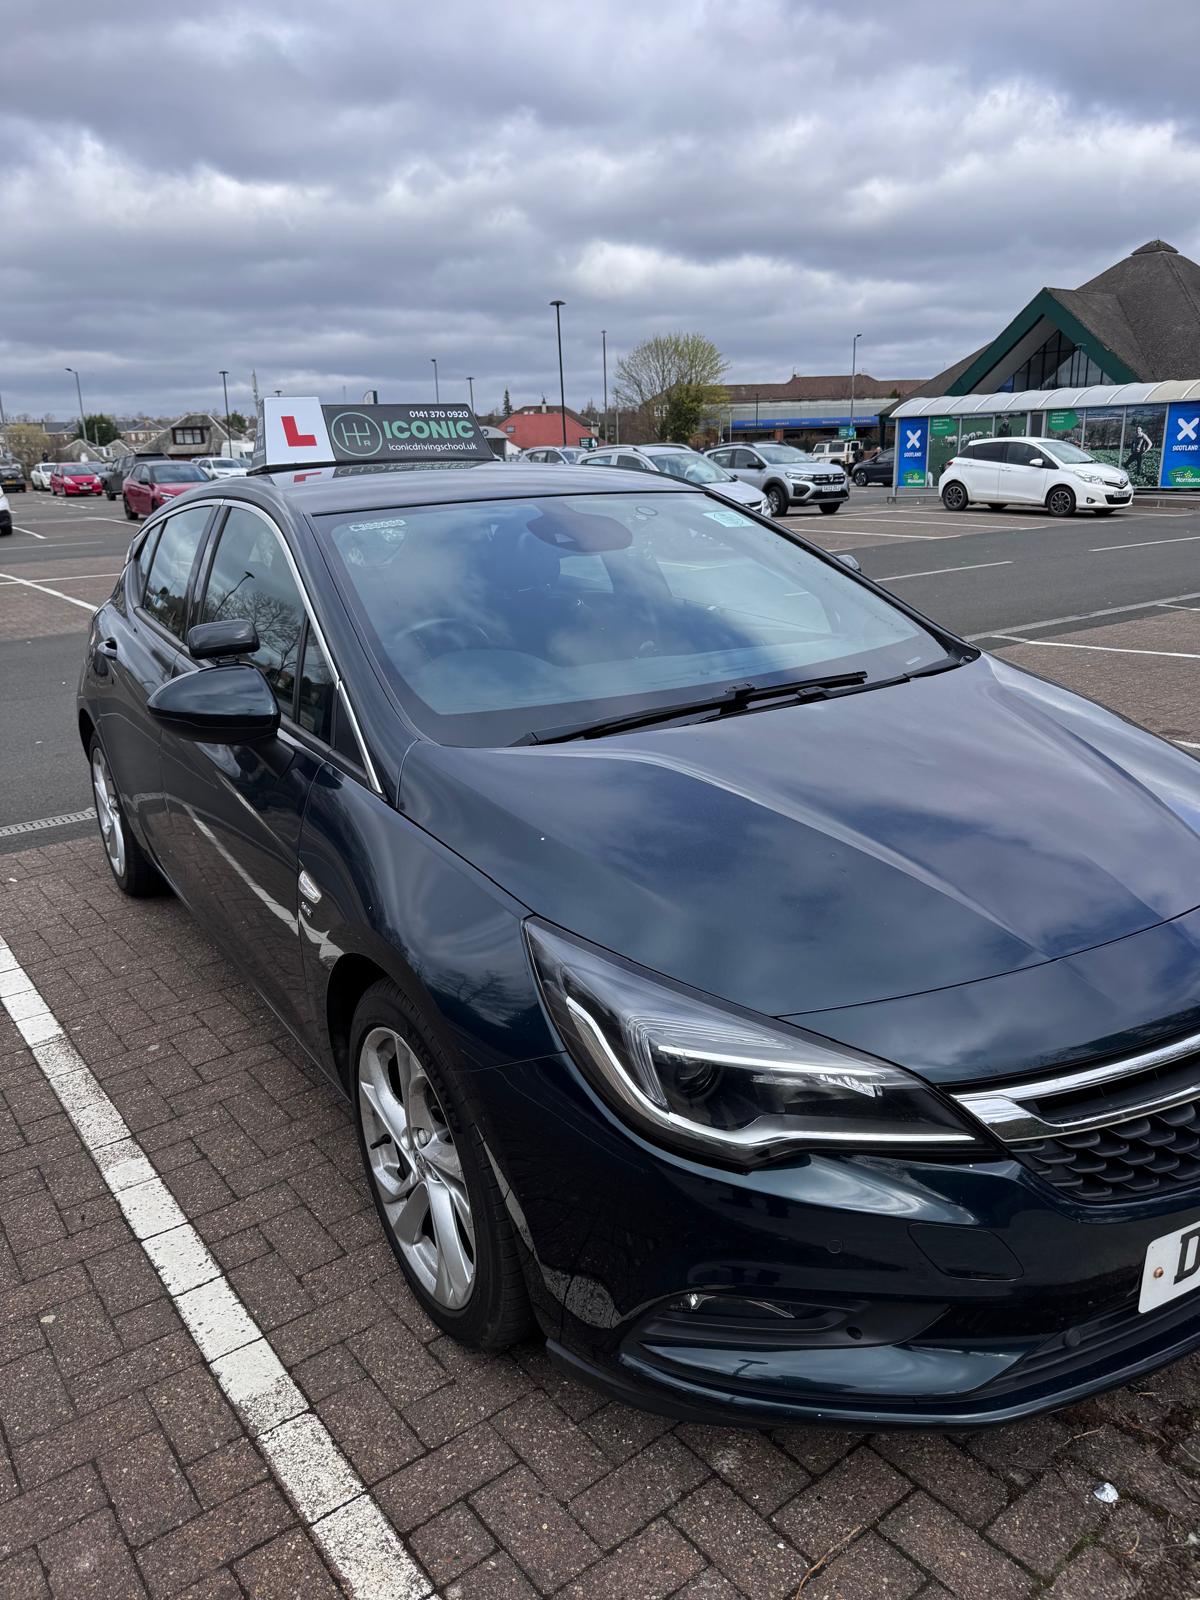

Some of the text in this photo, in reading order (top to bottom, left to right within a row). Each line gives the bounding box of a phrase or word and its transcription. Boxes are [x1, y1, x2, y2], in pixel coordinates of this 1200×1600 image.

[409, 410, 469, 418] 0141 370 0920
[280, 415, 318, 447] L
[382, 420, 475, 439] ICONIC
[388, 442, 478, 452] iconicdrivingschool.uk
[1172, 444, 1199, 452] SCOTLAND
